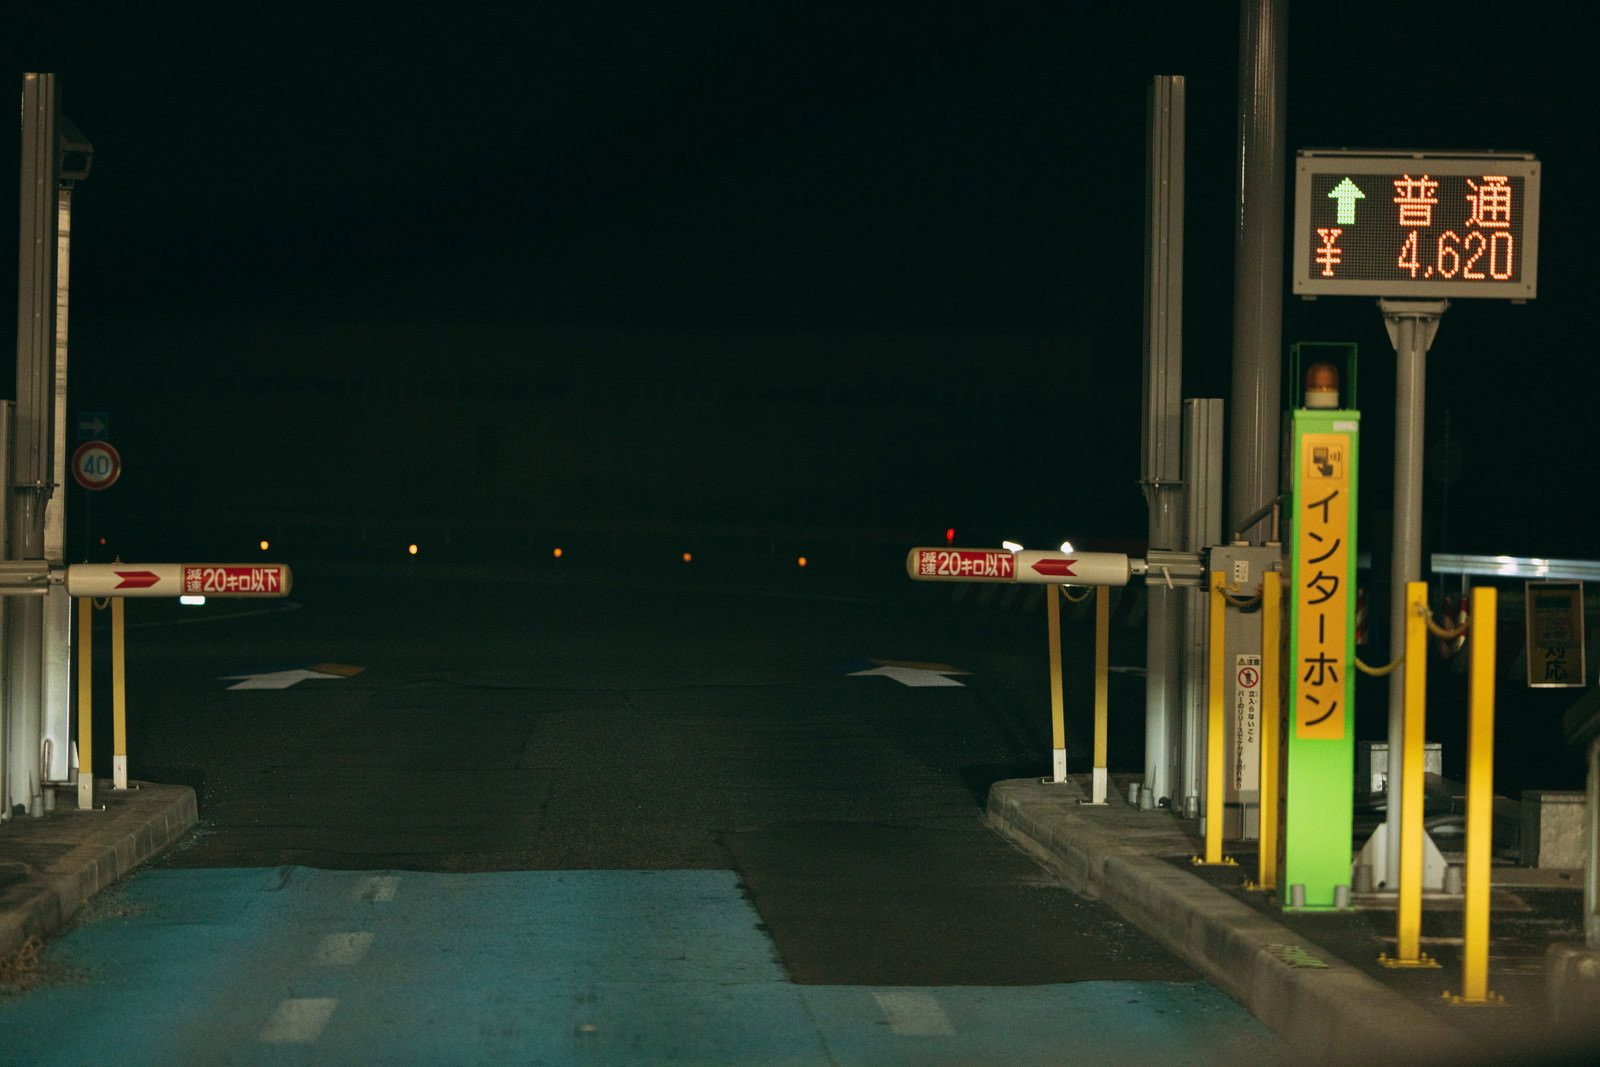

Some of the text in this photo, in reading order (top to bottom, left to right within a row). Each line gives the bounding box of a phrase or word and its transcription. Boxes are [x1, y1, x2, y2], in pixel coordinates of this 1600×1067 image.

[1394, 174, 1512, 228] 普通
[84, 456, 109, 476] 40
[938, 552, 1012, 577] 20キロ以下
[203, 568, 279, 592] 20キロ以下
[1304, 490, 1341, 727] インターホン
